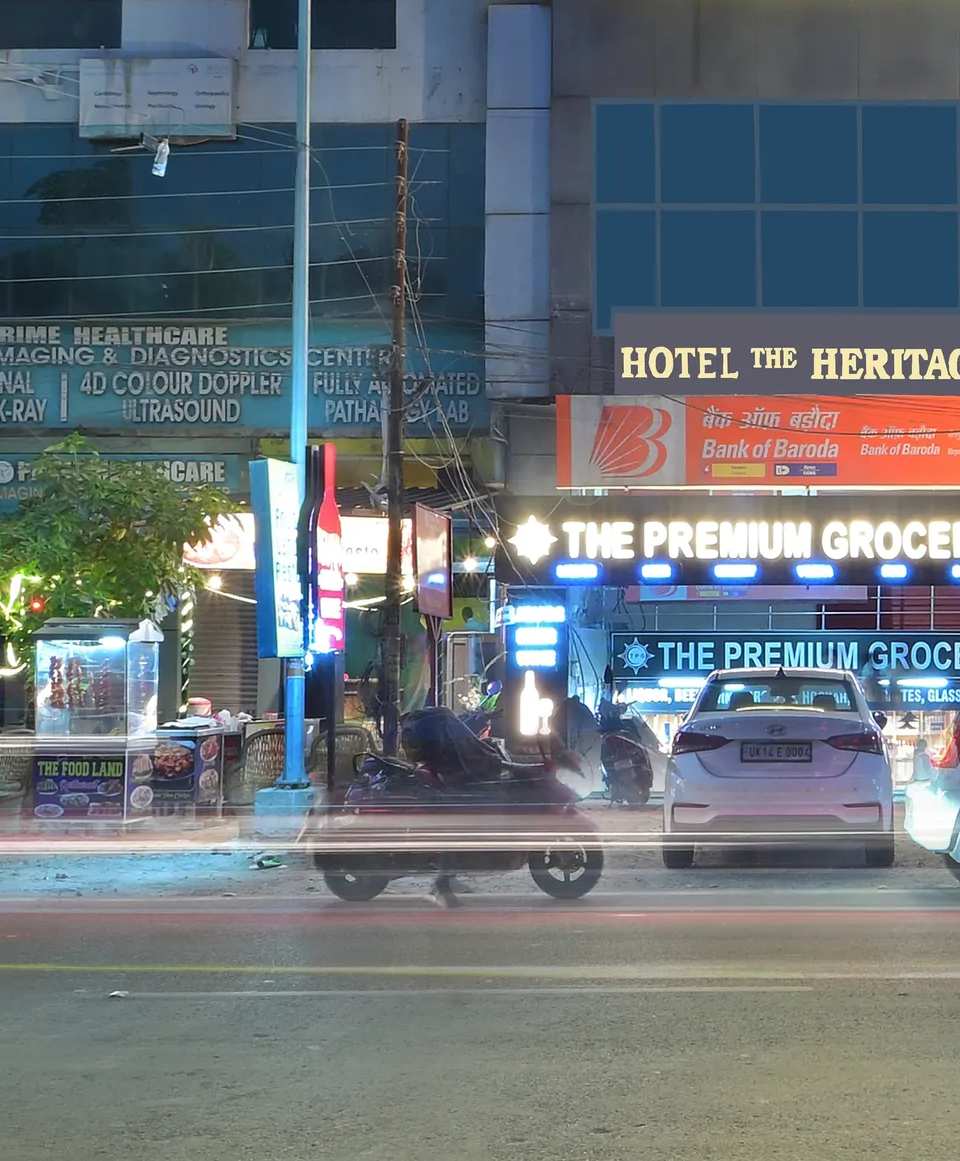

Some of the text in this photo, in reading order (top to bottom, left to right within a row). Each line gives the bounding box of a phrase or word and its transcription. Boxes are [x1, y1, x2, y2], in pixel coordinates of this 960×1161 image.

[74, 326, 228, 346] HEALTHCARE
[103, 348, 119, 365] &
[131, 347, 293, 367] DIAGNOSTICS
[621, 346, 739, 379] HOTEL
[750, 347, 797, 369] THE
[80, 371, 283, 395] 4D COLOUR DOPPLER
[313, 372, 362, 395] FULLY
[122, 398, 241, 423] ULTRASOUND
[702, 405, 733, 429] बैंक
[789, 404, 840, 432] बड़ौदा
[702, 438, 840, 459] Bank of Baroda
[860, 443, 940, 456] Bank of Baroda
[562, 520, 635, 560] THE
[643, 520, 812, 560] PREMIUM
[658, 642, 715, 670] THE
[724, 641, 858, 670] PREMIUM
[38, 761, 123, 776] THE FOOD LAND
